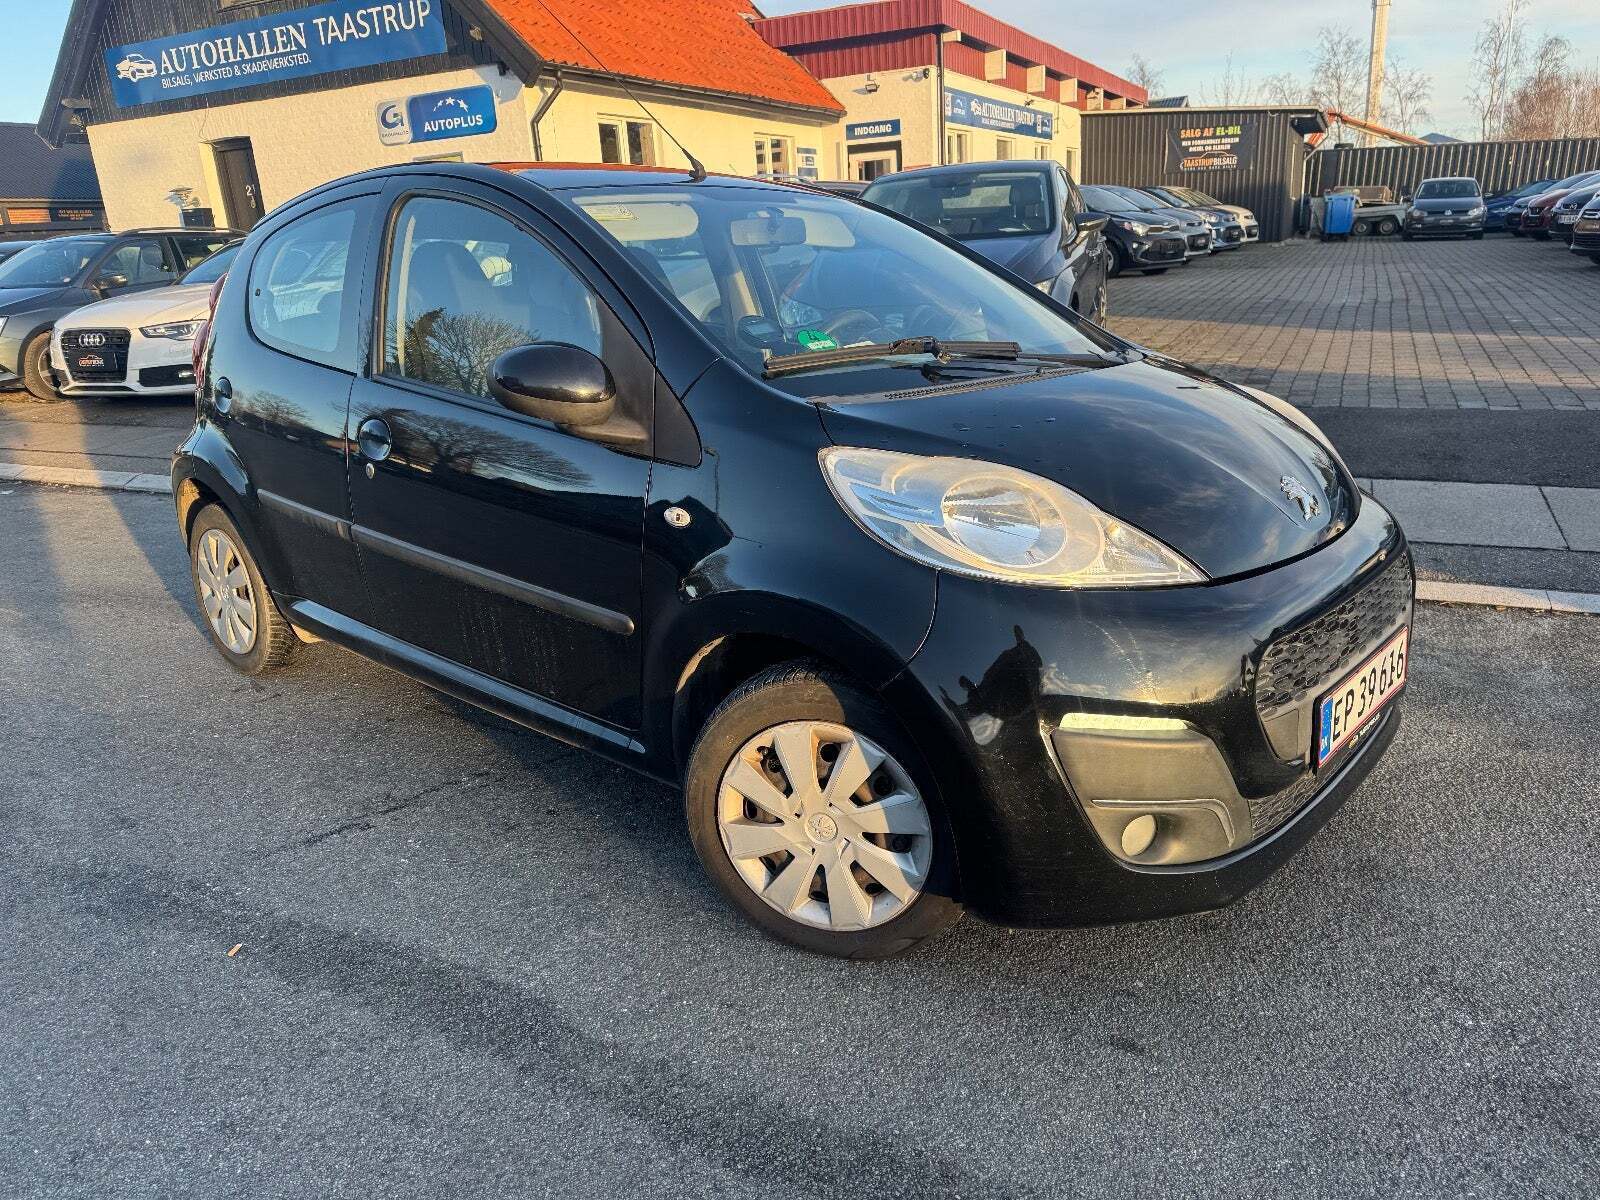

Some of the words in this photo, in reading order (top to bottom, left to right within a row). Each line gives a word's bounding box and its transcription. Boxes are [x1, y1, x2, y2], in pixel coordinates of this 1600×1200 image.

[160, 23, 307, 76] AUTOHALLEN
[312, 0, 431, 46] TAASTRUP
[161, 74, 193, 89] BILSALG,
[193, 67, 233, 83] VÆRKSTED
[234, 66, 241, 76] &
[242, 53, 311, 75] SKADEVÆRKSTED.
[423, 114, 484, 133] AUTOPLUS
[854, 123, 892, 136] INDGANG
[1180, 128, 1201, 138] SALG
[1202, 127, 1214, 137] AF
[1215, 125, 1242, 136] EL-BIL
